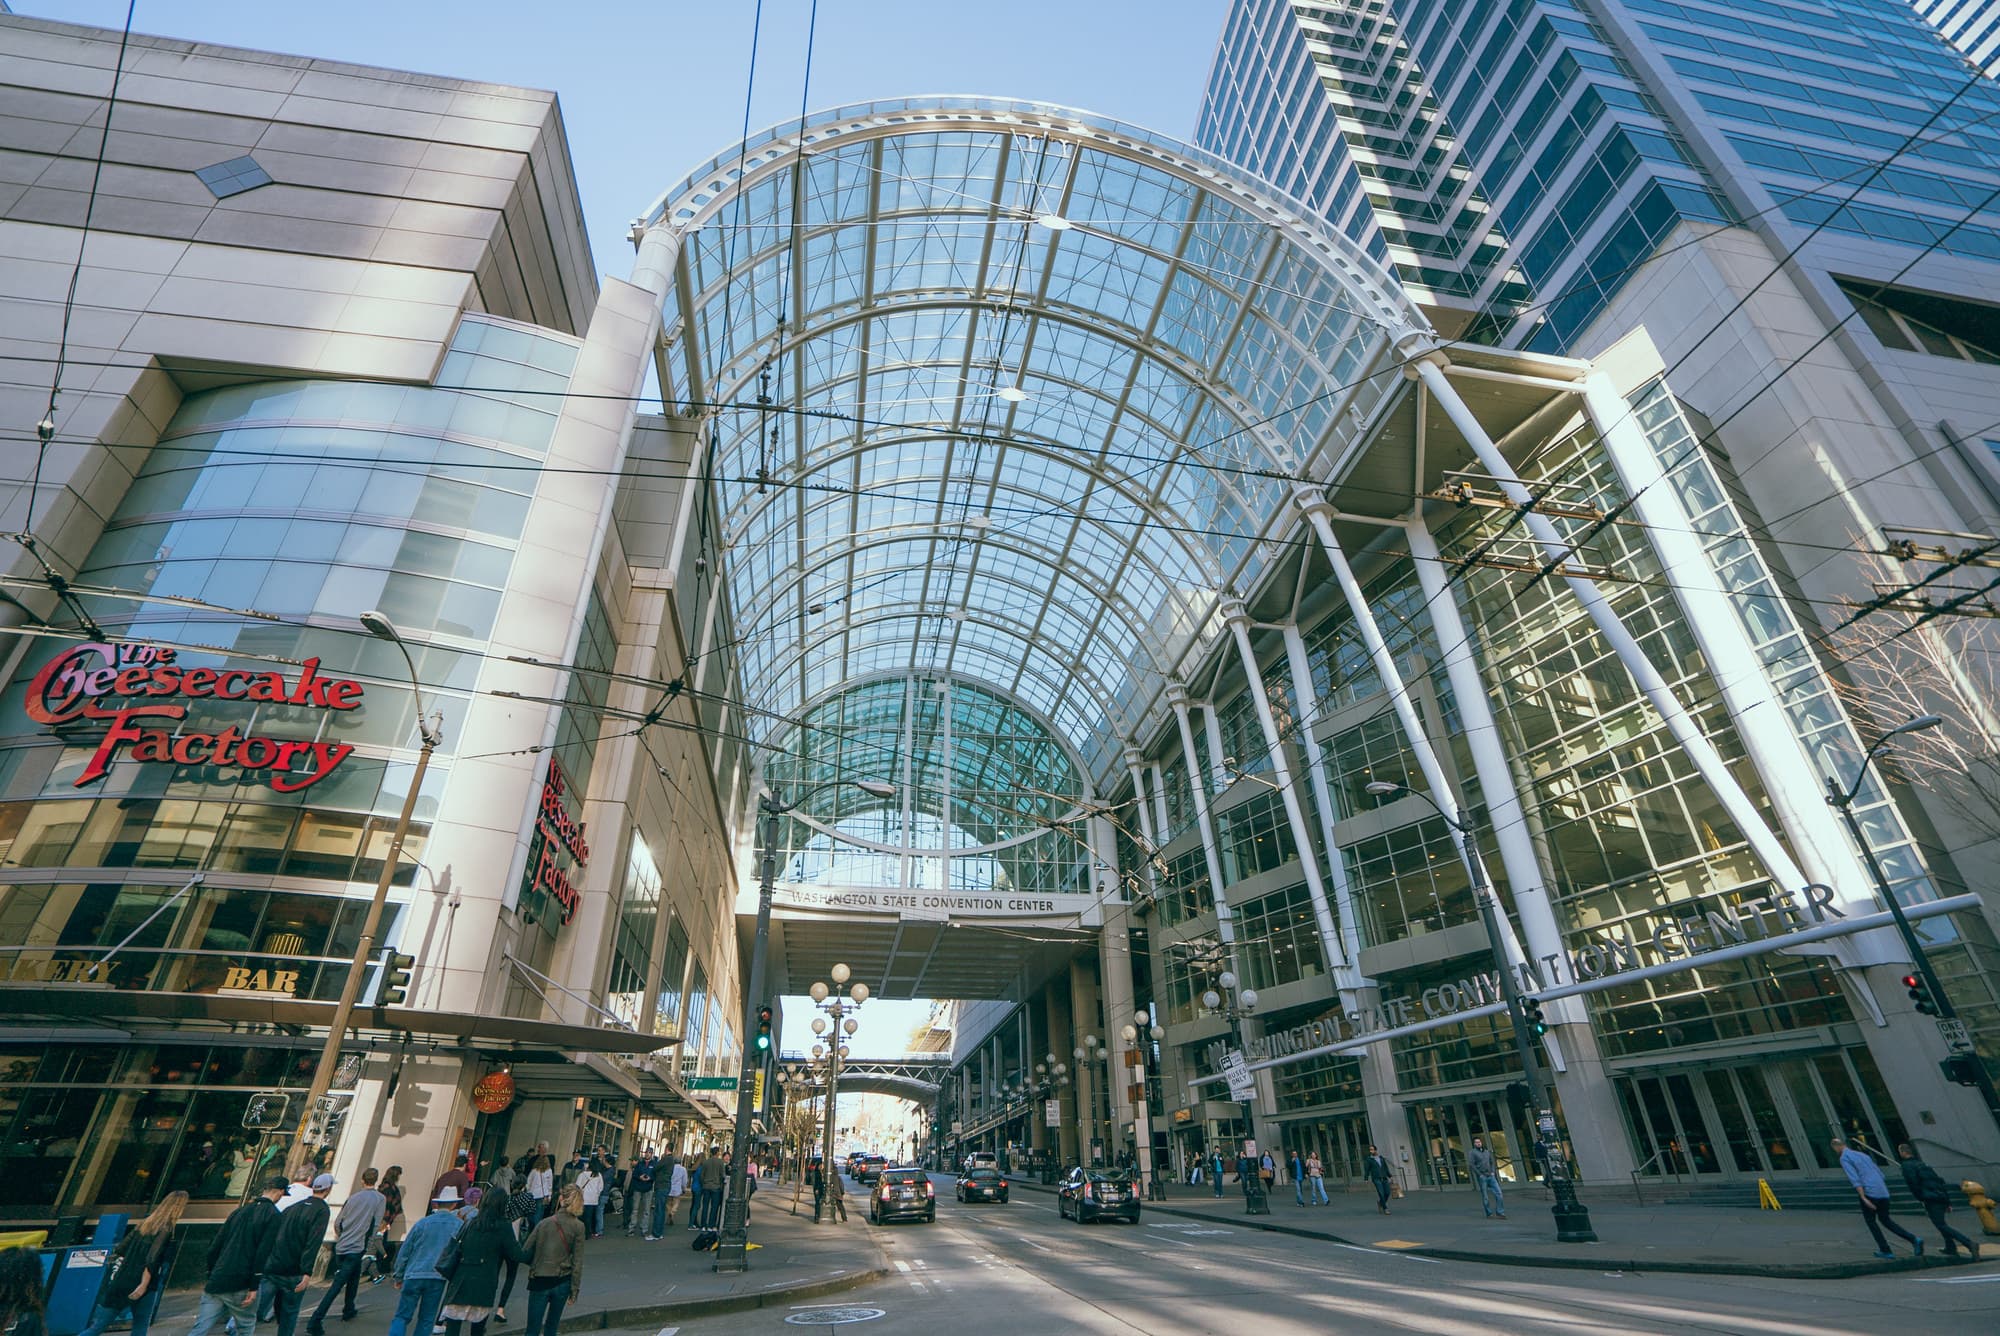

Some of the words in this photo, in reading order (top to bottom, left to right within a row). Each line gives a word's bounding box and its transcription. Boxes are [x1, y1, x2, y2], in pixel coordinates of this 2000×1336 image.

[119, 643, 176, 665] The
[24, 642, 364, 725] Cheesecake
[73, 697, 356, 793] Factory
[541, 783, 590, 868] eesecake
[531, 808, 582, 927] Factory
[792, 891, 877, 905] WASHINGTON
[882, 895, 917, 907] STATE
[922, 896, 1003, 910] CONVENTION
[1008, 899, 1054, 911] CENTER
[221, 966, 300, 994] BAR
[1207, 1014, 1344, 1074] WSHINGTON
[1346, 995, 1417, 1039] STATE
[1653, 884, 1848, 957] CENTER
[1940, 1021, 1961, 1031] ONE
[1943, 1030, 1965, 1041] WAY
[720, 1080, 733, 1088] Ave
[1227, 1066, 1247, 1080] BUSES
[1231, 1073, 1247, 1086] ONLY
